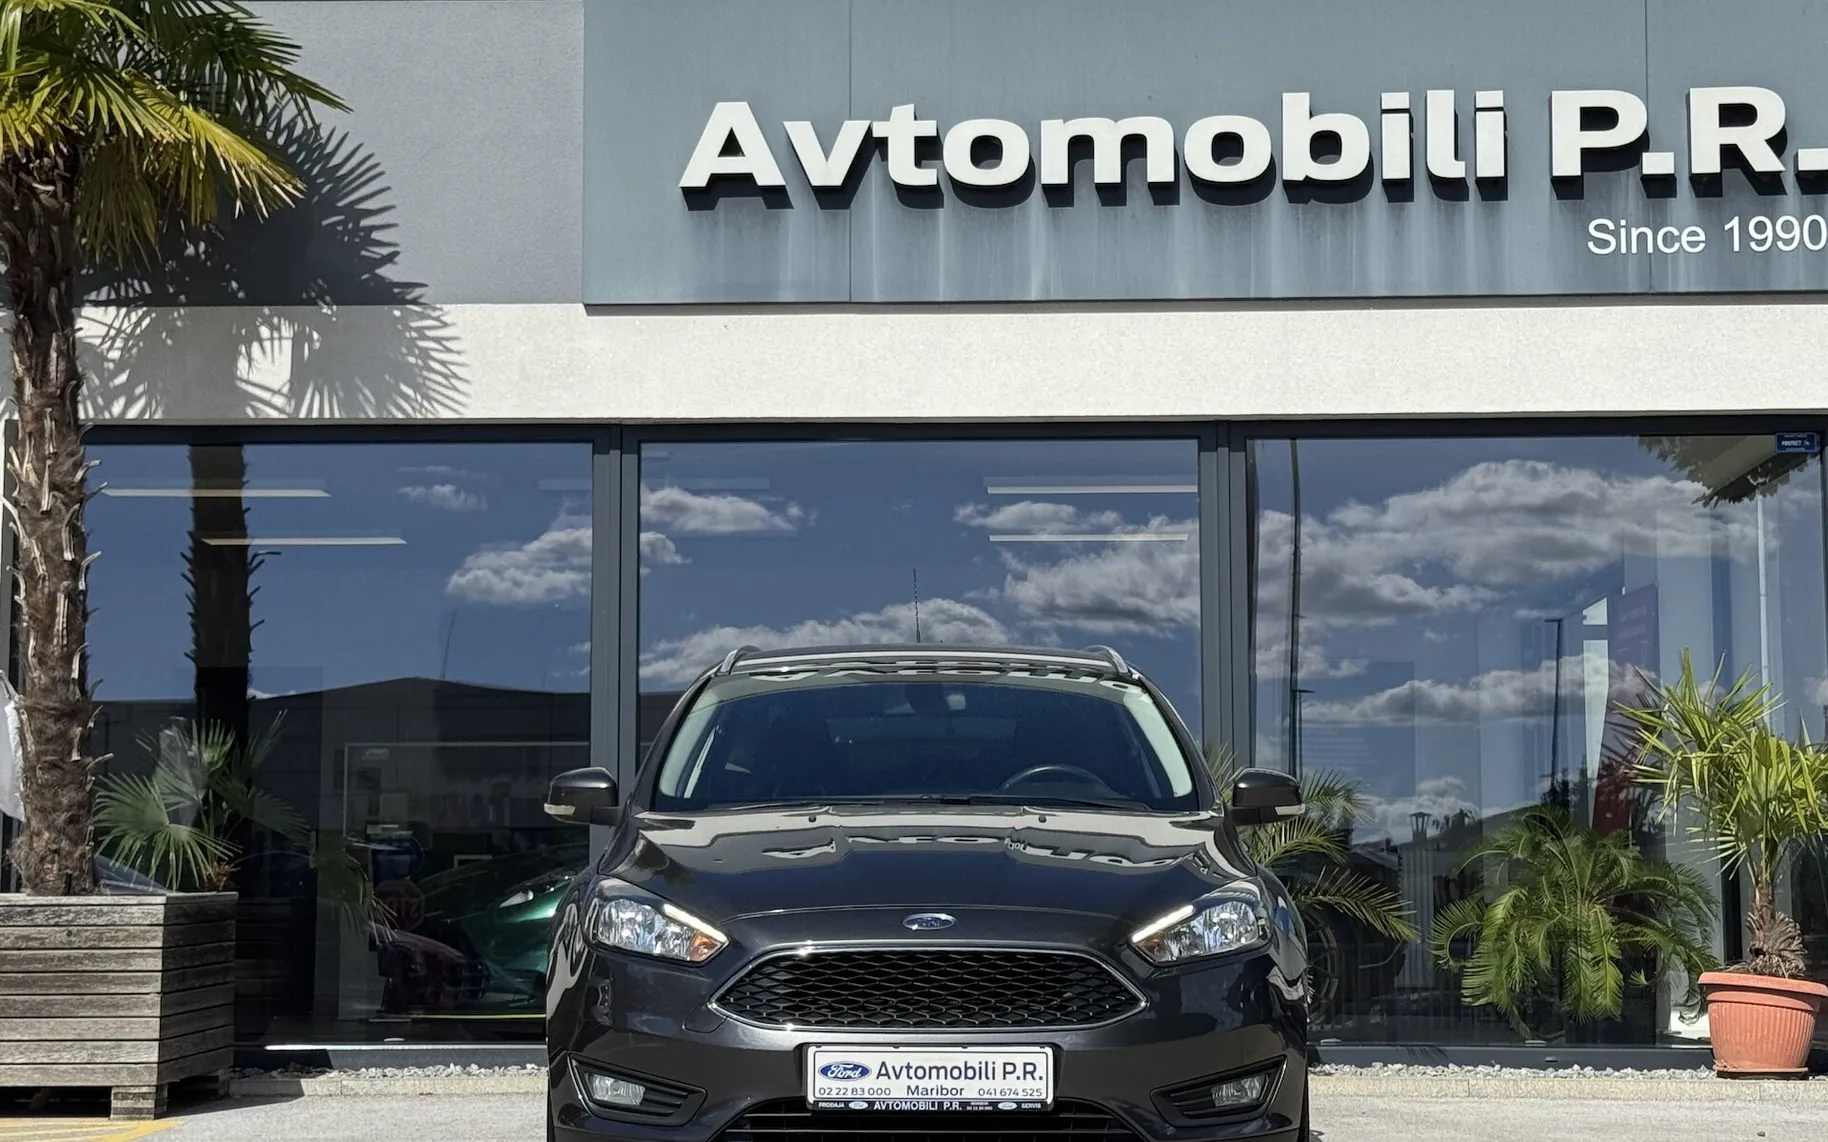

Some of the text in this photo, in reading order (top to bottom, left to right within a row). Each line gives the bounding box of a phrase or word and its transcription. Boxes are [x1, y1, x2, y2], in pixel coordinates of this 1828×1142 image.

[679, 86, 1828, 188] Avtomobili P.R.
[1587, 214, 1828, 254] Since 1990
[825, 1063, 864, 1079] Ford
[876, 1061, 1044, 1081] Avtomobili P.R.
[818, 1087, 892, 1096] 02 22 83 000
[906, 1085, 965, 1096] Maribor
[978, 1088, 1043, 1097] 041 674 525
[873, 1101, 938, 1110] AVTOMOBILI
[943, 1101, 963, 1110] P.R.
